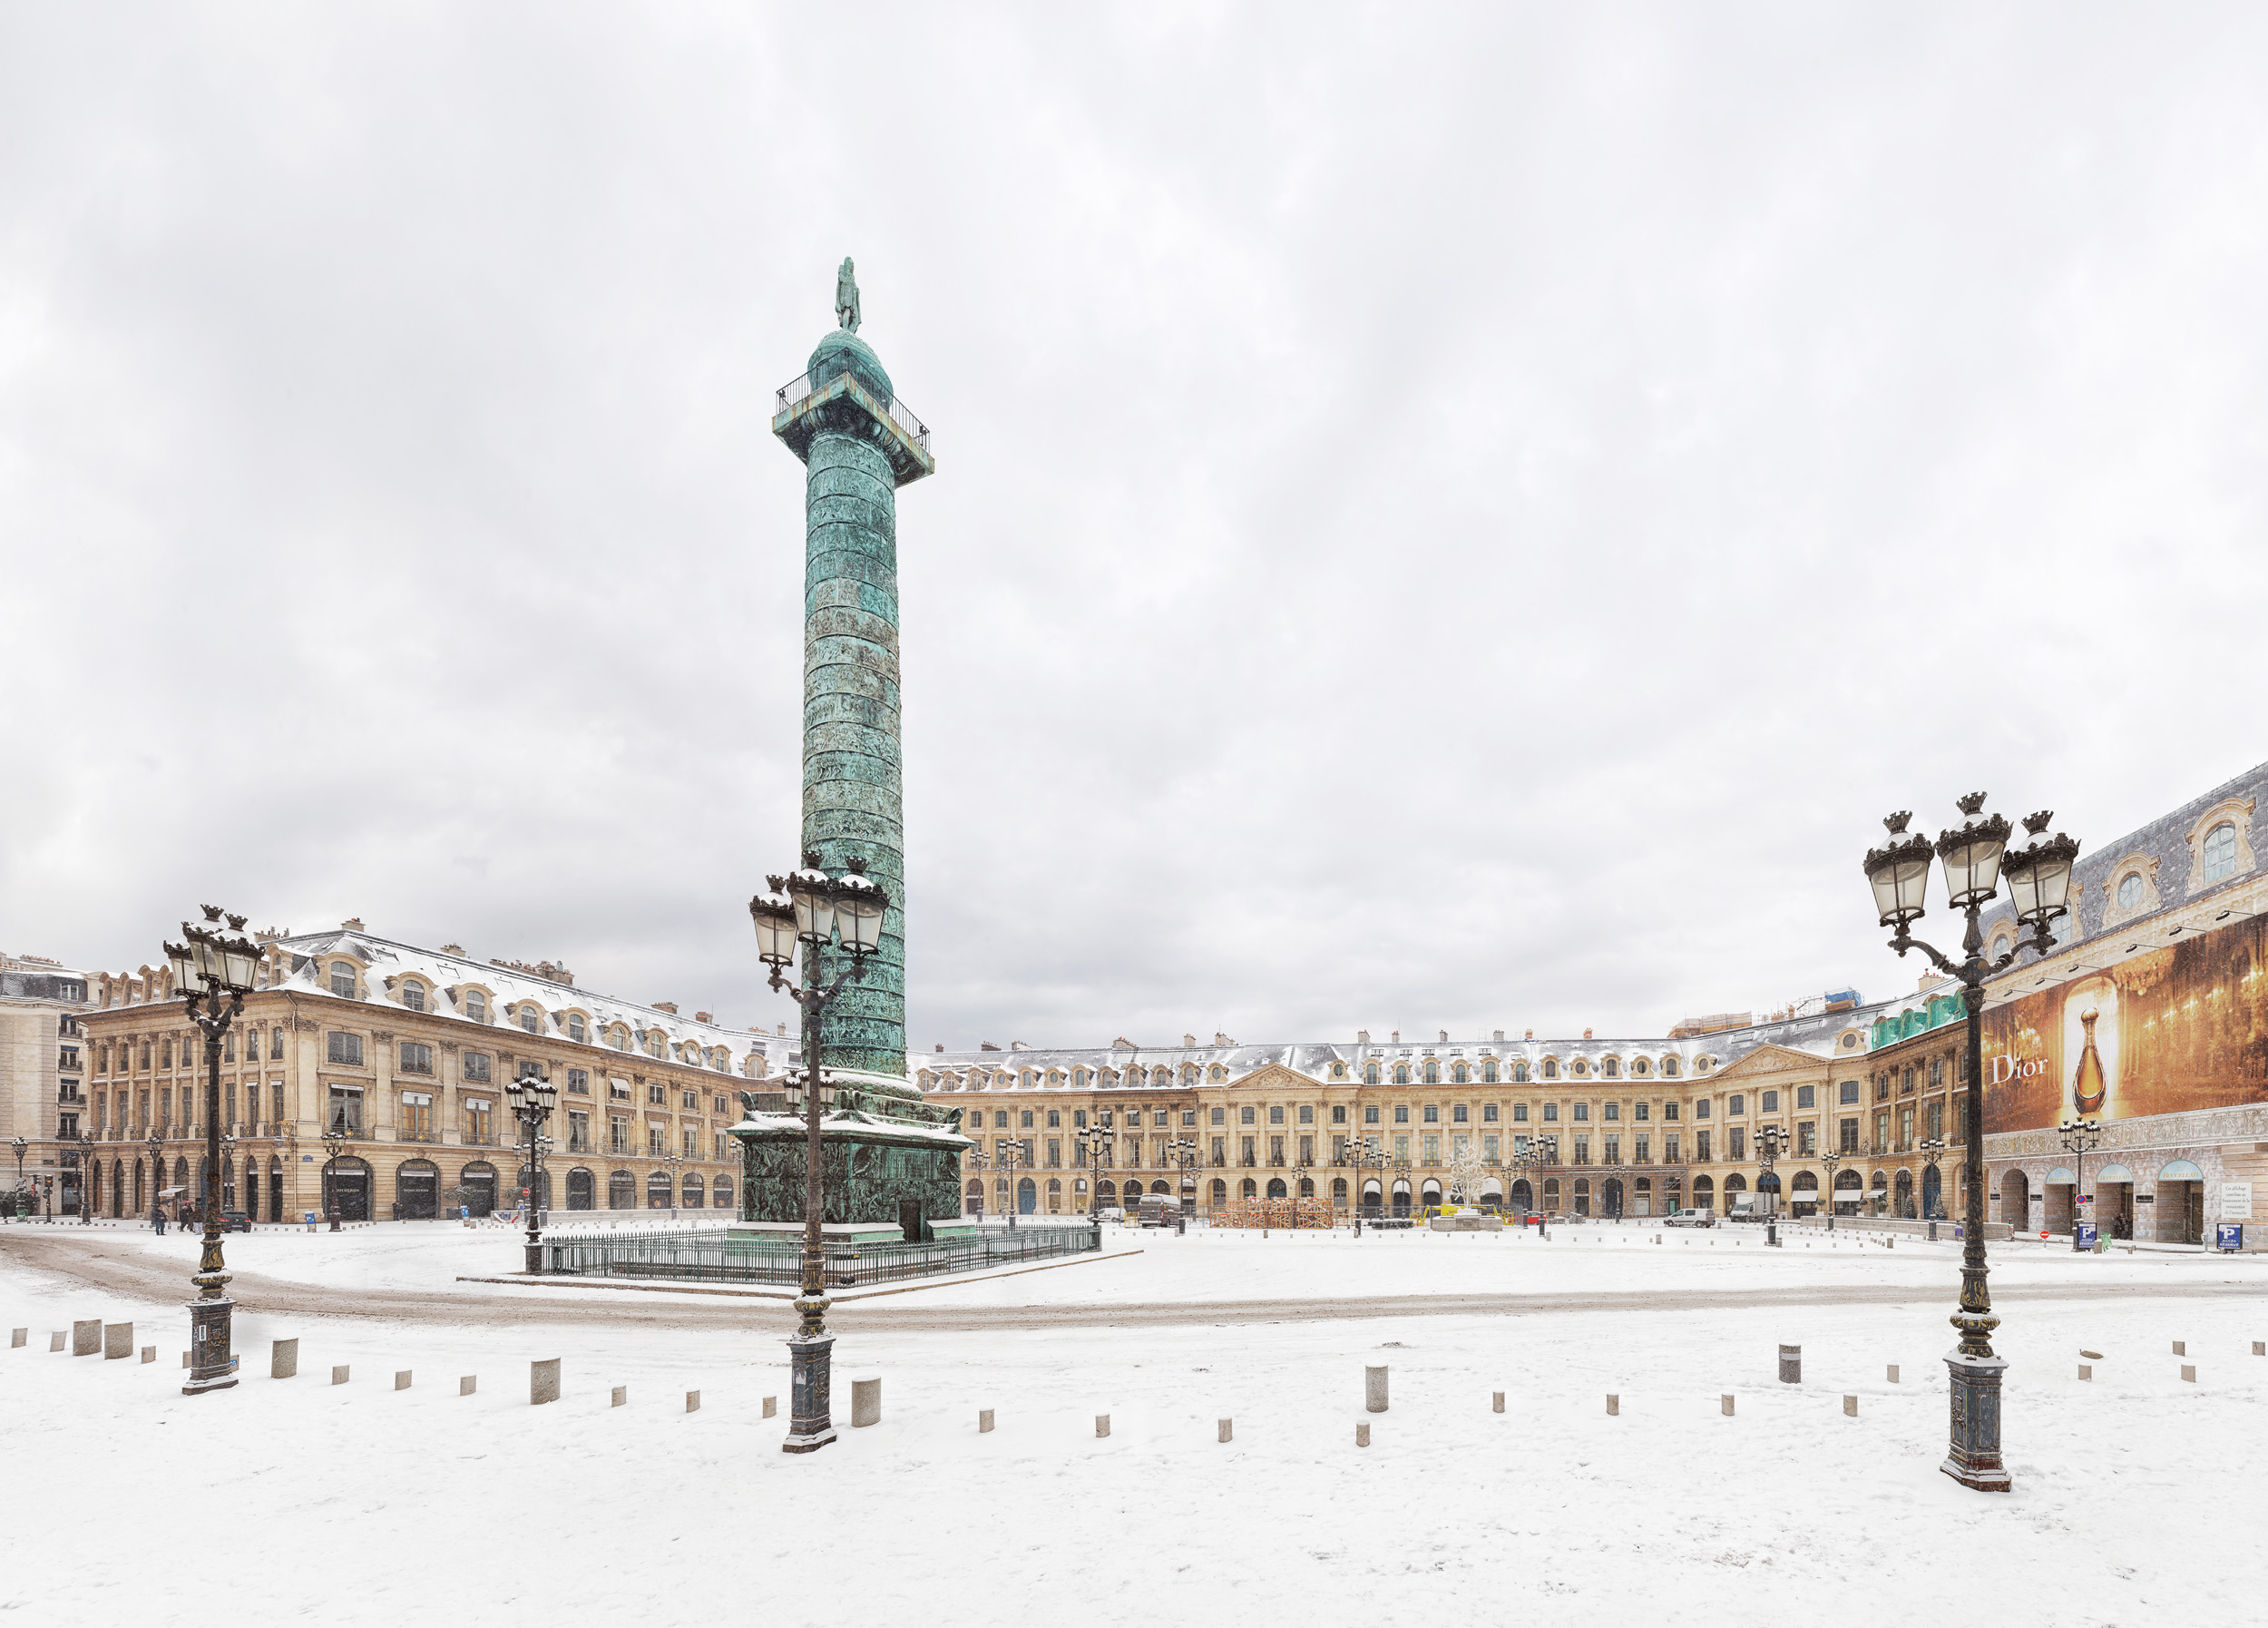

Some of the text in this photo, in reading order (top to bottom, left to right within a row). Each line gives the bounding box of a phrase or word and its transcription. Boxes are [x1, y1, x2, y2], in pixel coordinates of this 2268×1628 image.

[1989, 1054, 2048, 1085] Dior
[2082, 1227, 2092, 1239] P
[2224, 1228, 2235, 1239] P
